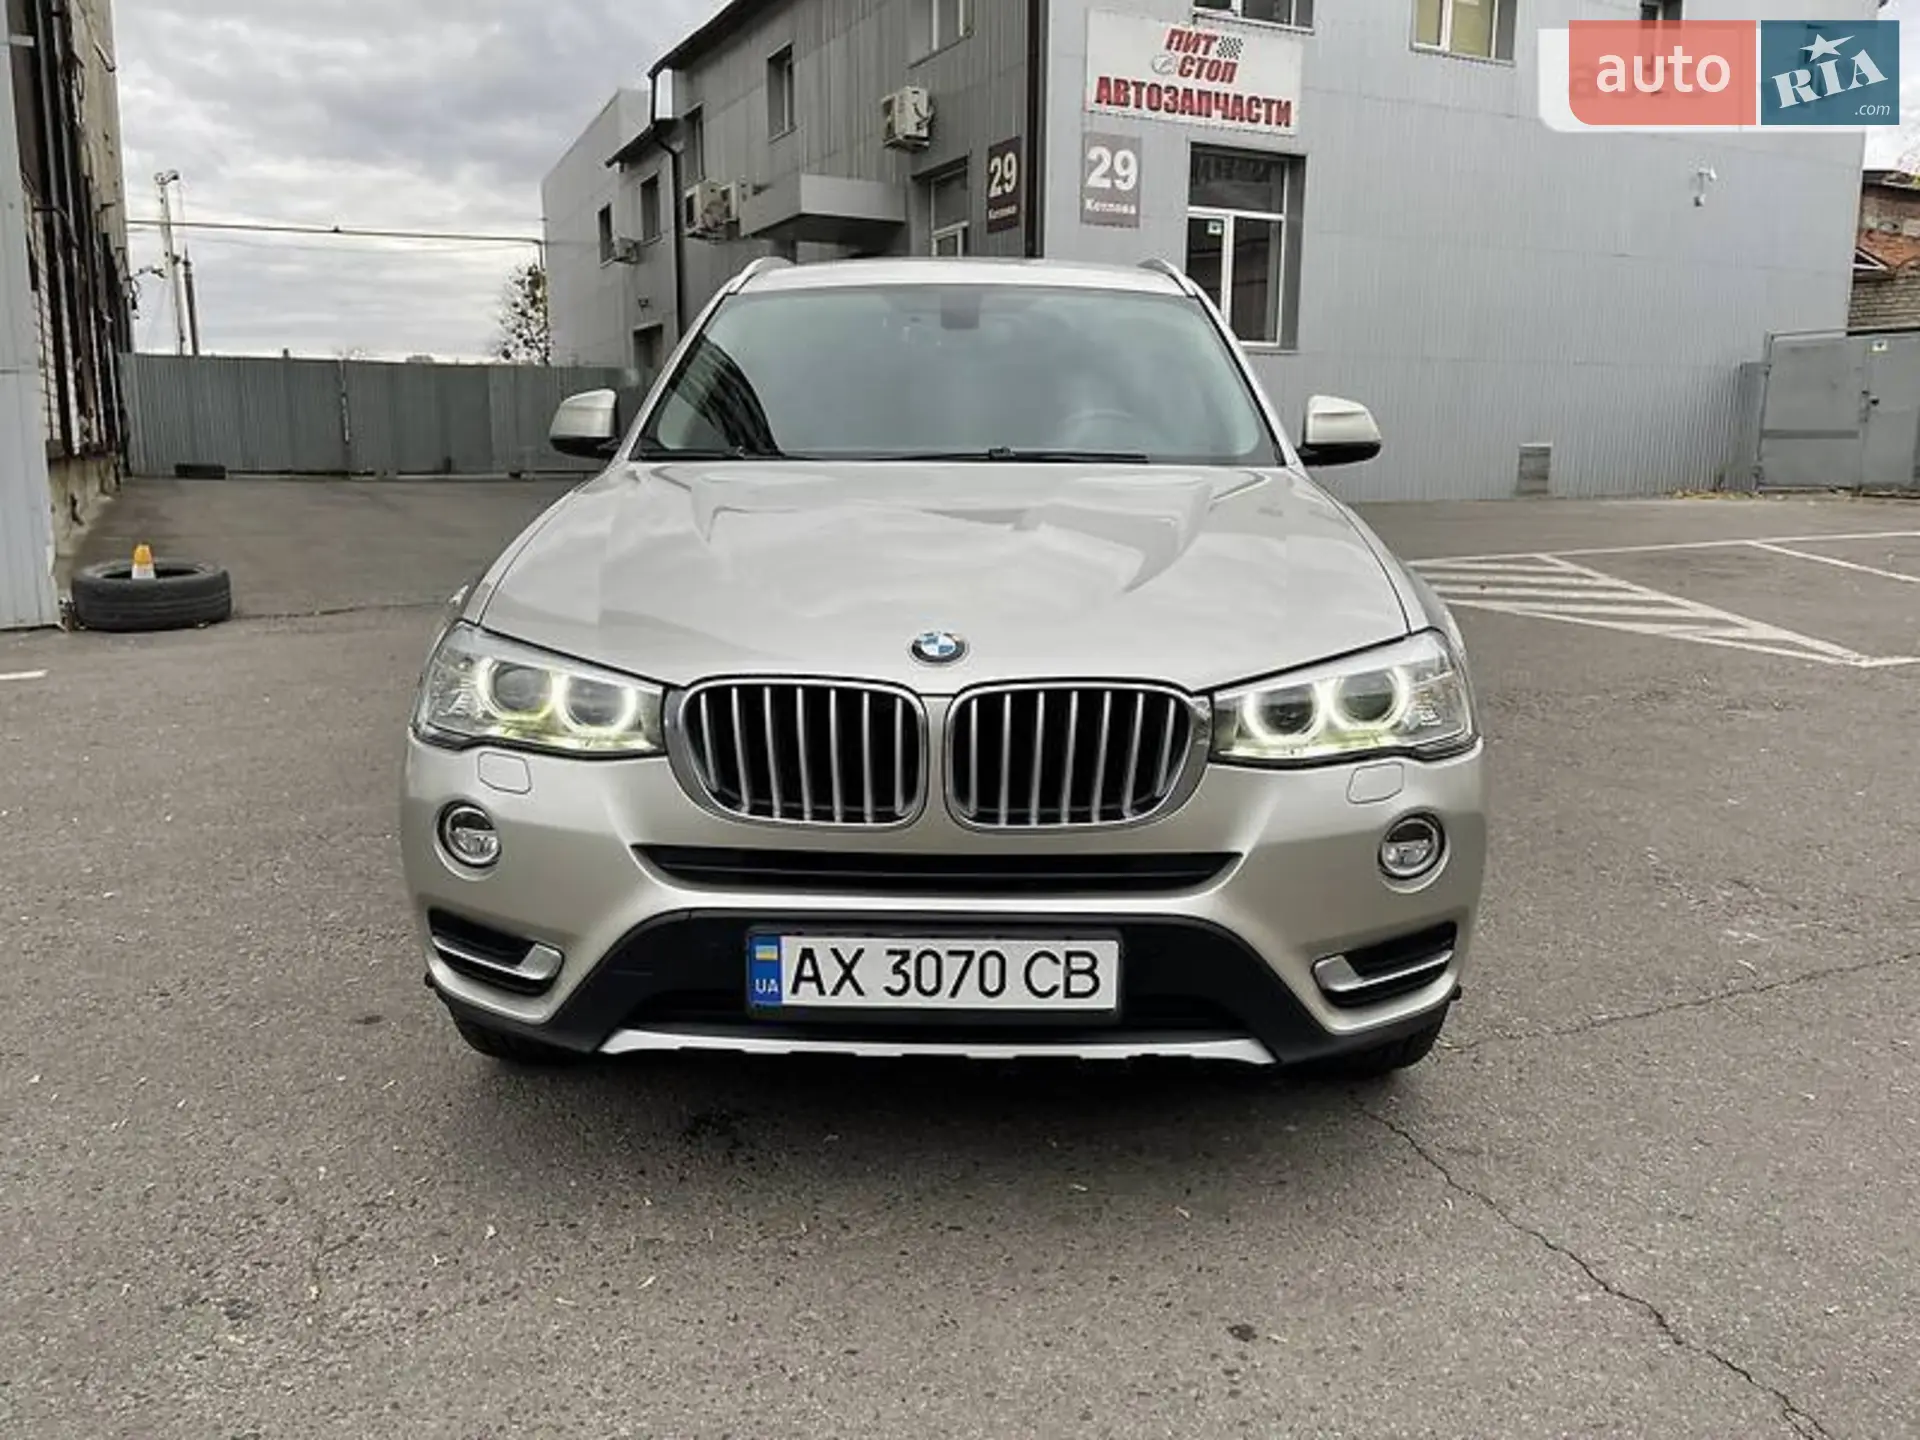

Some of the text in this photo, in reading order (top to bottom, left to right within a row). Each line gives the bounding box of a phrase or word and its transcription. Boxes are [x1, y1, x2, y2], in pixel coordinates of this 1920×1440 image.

[1165, 28, 1218, 55] ПИТ
[1178, 54, 1238, 84] СТОП
[1095, 76, 1292, 127] АВТОЗАПЧАСТИ
[988, 152, 1017, 198] 29
[1086, 145, 1138, 191] 29
[755, 979, 779, 993] UA
[790, 947, 1101, 1000] AX 3070 CB
